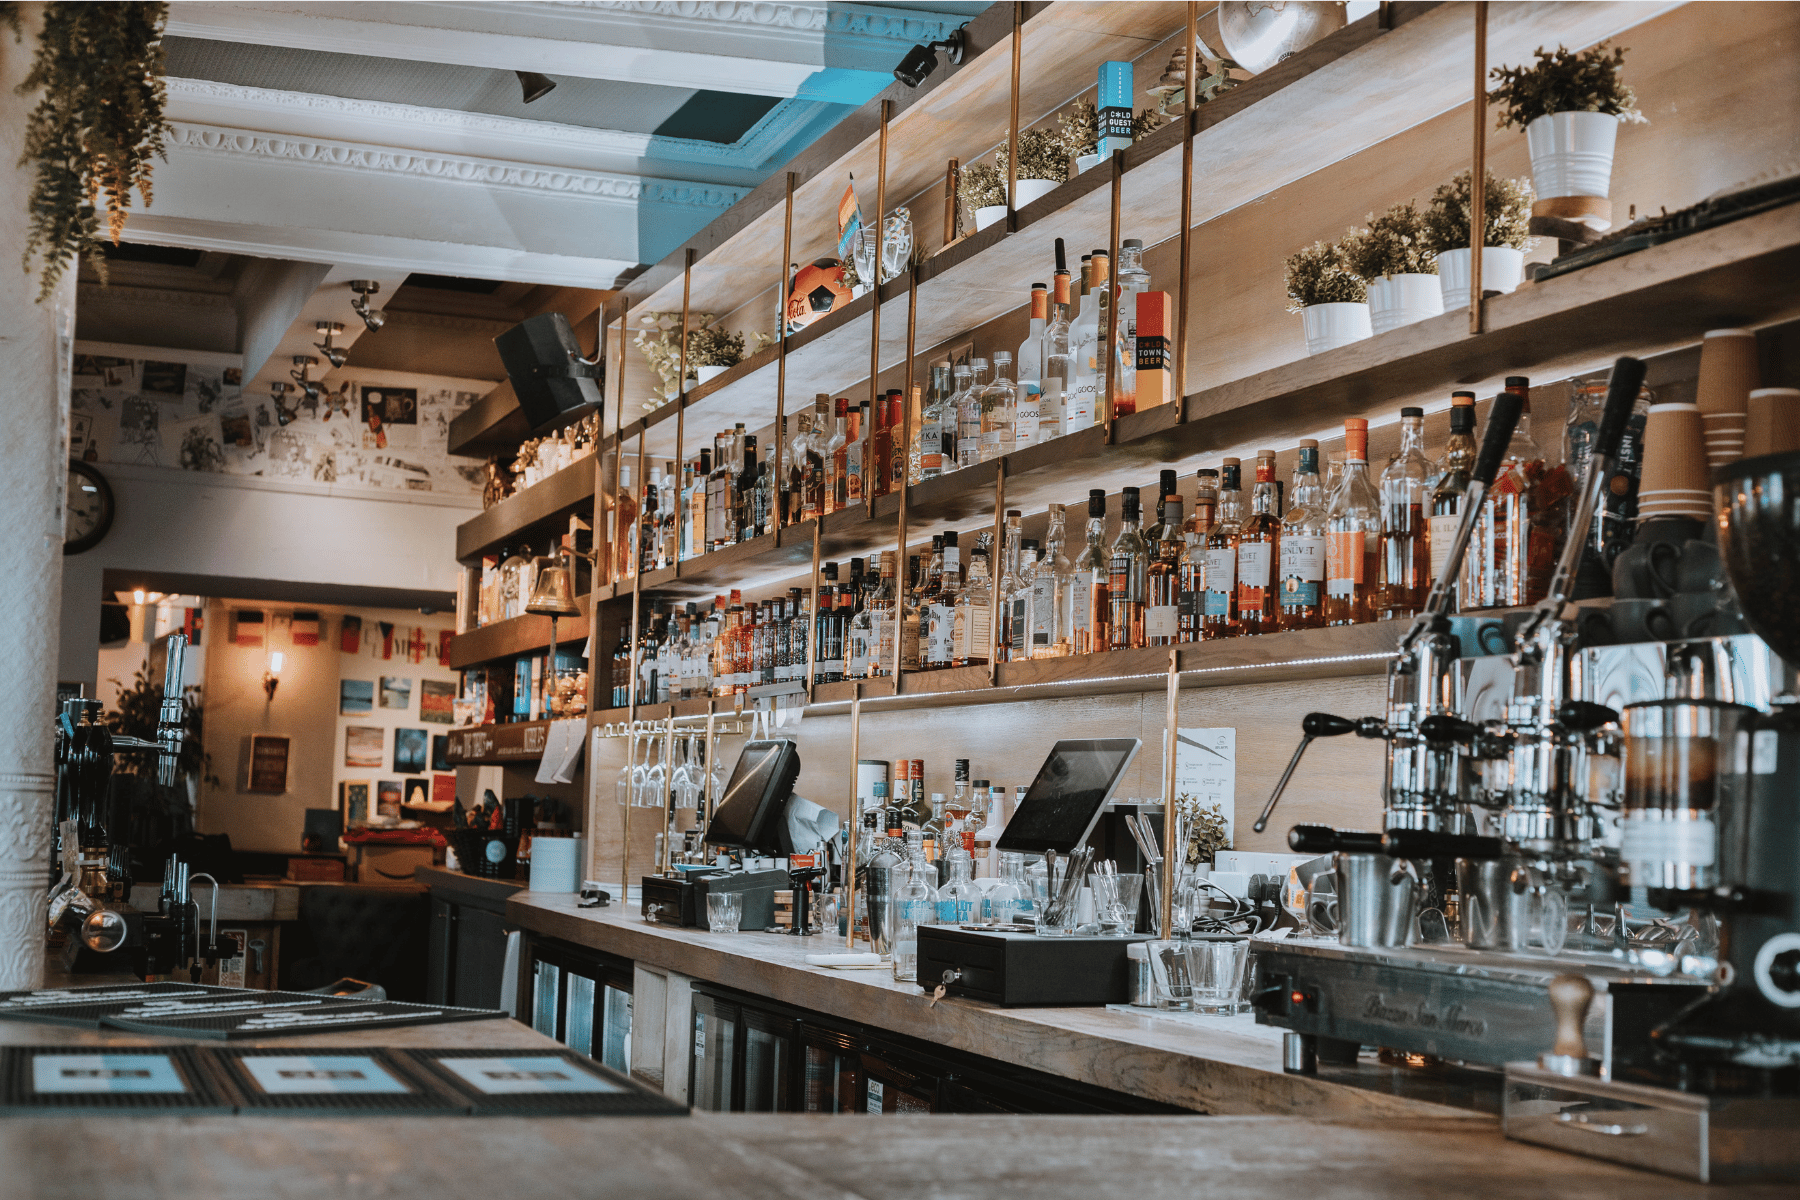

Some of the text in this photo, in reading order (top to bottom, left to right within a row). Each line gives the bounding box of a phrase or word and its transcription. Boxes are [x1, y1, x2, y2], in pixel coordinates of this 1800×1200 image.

[1110, 126, 1131, 134] BEER
[1078, 385, 1096, 393] GOOS
[1019, 410, 1040, 418] GOOS
